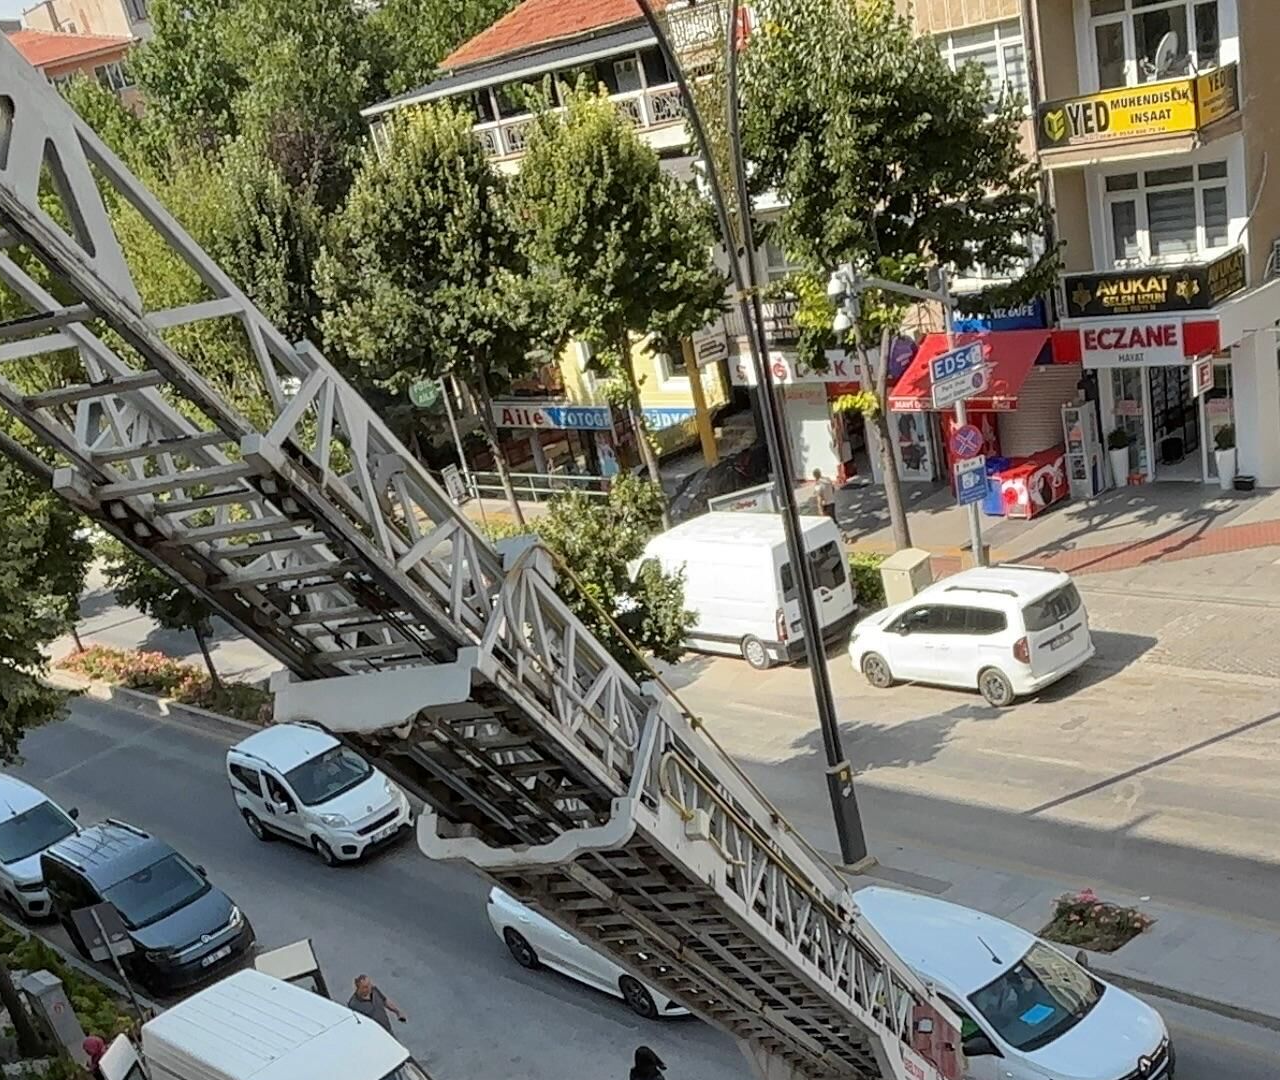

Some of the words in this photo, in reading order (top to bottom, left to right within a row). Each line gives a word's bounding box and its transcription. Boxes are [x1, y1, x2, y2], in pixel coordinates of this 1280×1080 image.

[1066, 99, 1110, 138] YED
[1096, 274, 1170, 297] AVUKAT
[1083, 323, 1178, 351] ECZANE
[934, 351, 966, 379] EDS
[1118, 352, 1145, 363] HAYAT
[1199, 364, 1210, 386] E
[501, 407, 544, 425] Aile
